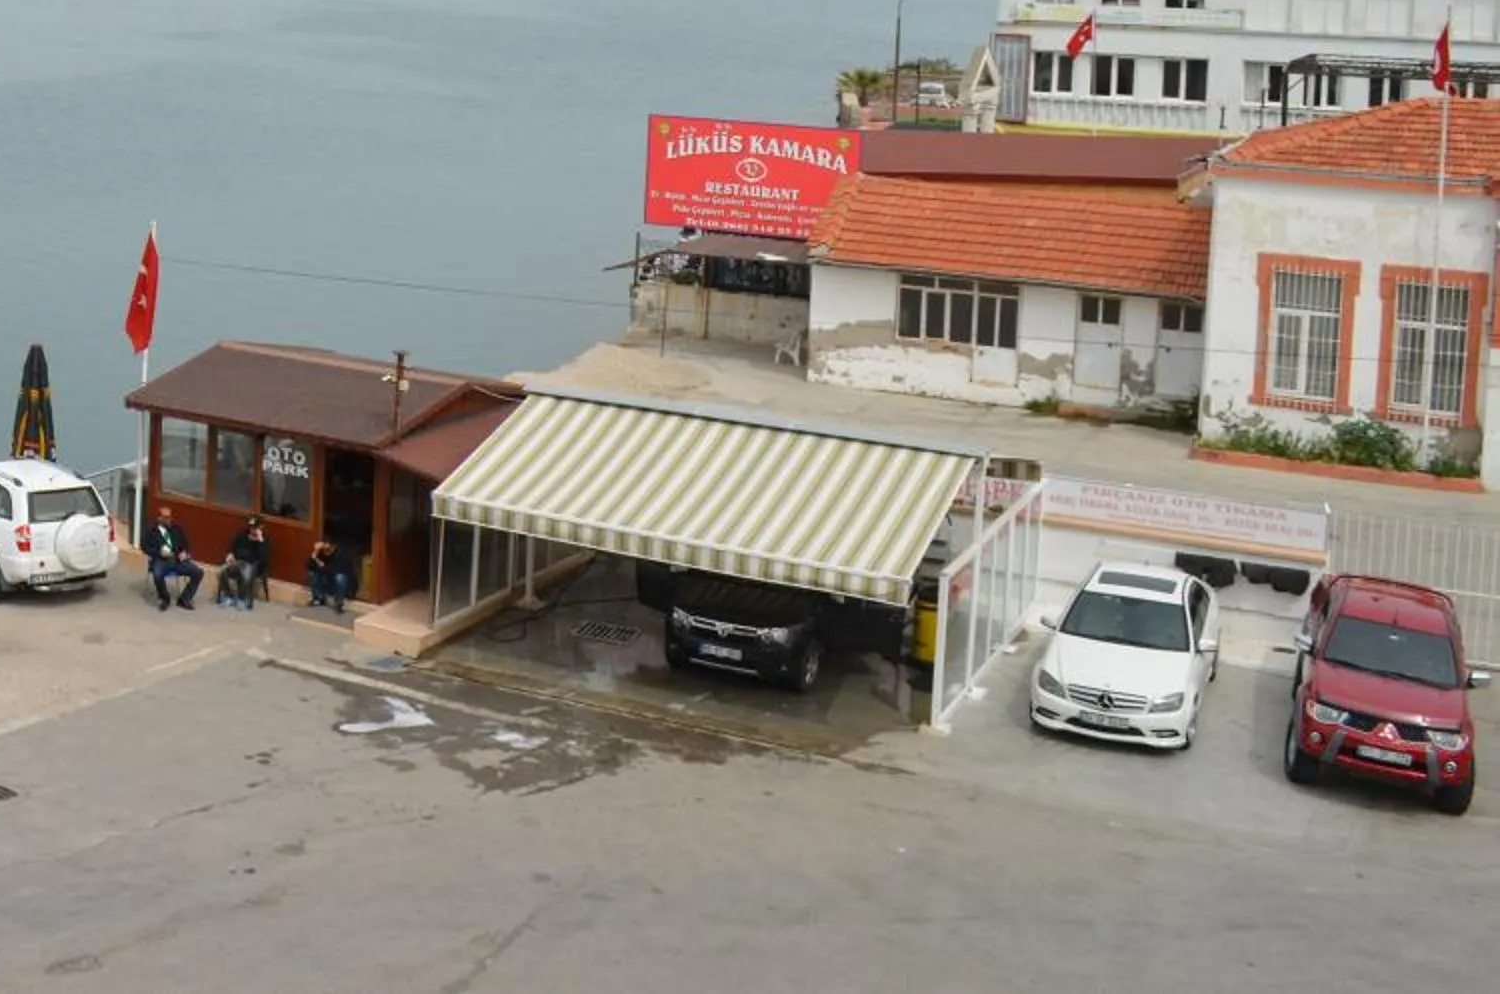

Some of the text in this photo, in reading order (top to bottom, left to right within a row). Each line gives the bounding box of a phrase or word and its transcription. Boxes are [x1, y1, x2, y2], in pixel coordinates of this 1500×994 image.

[666, 130, 848, 174] LÜKÜS KAMARA
[704, 181, 800, 202] RESTAURANT
[266, 445, 307, 466] OTO
[261, 459, 310, 479] PARK
[1171, 495, 1208, 513] OTO
[1213, 498, 1288, 522] YIKAMA
